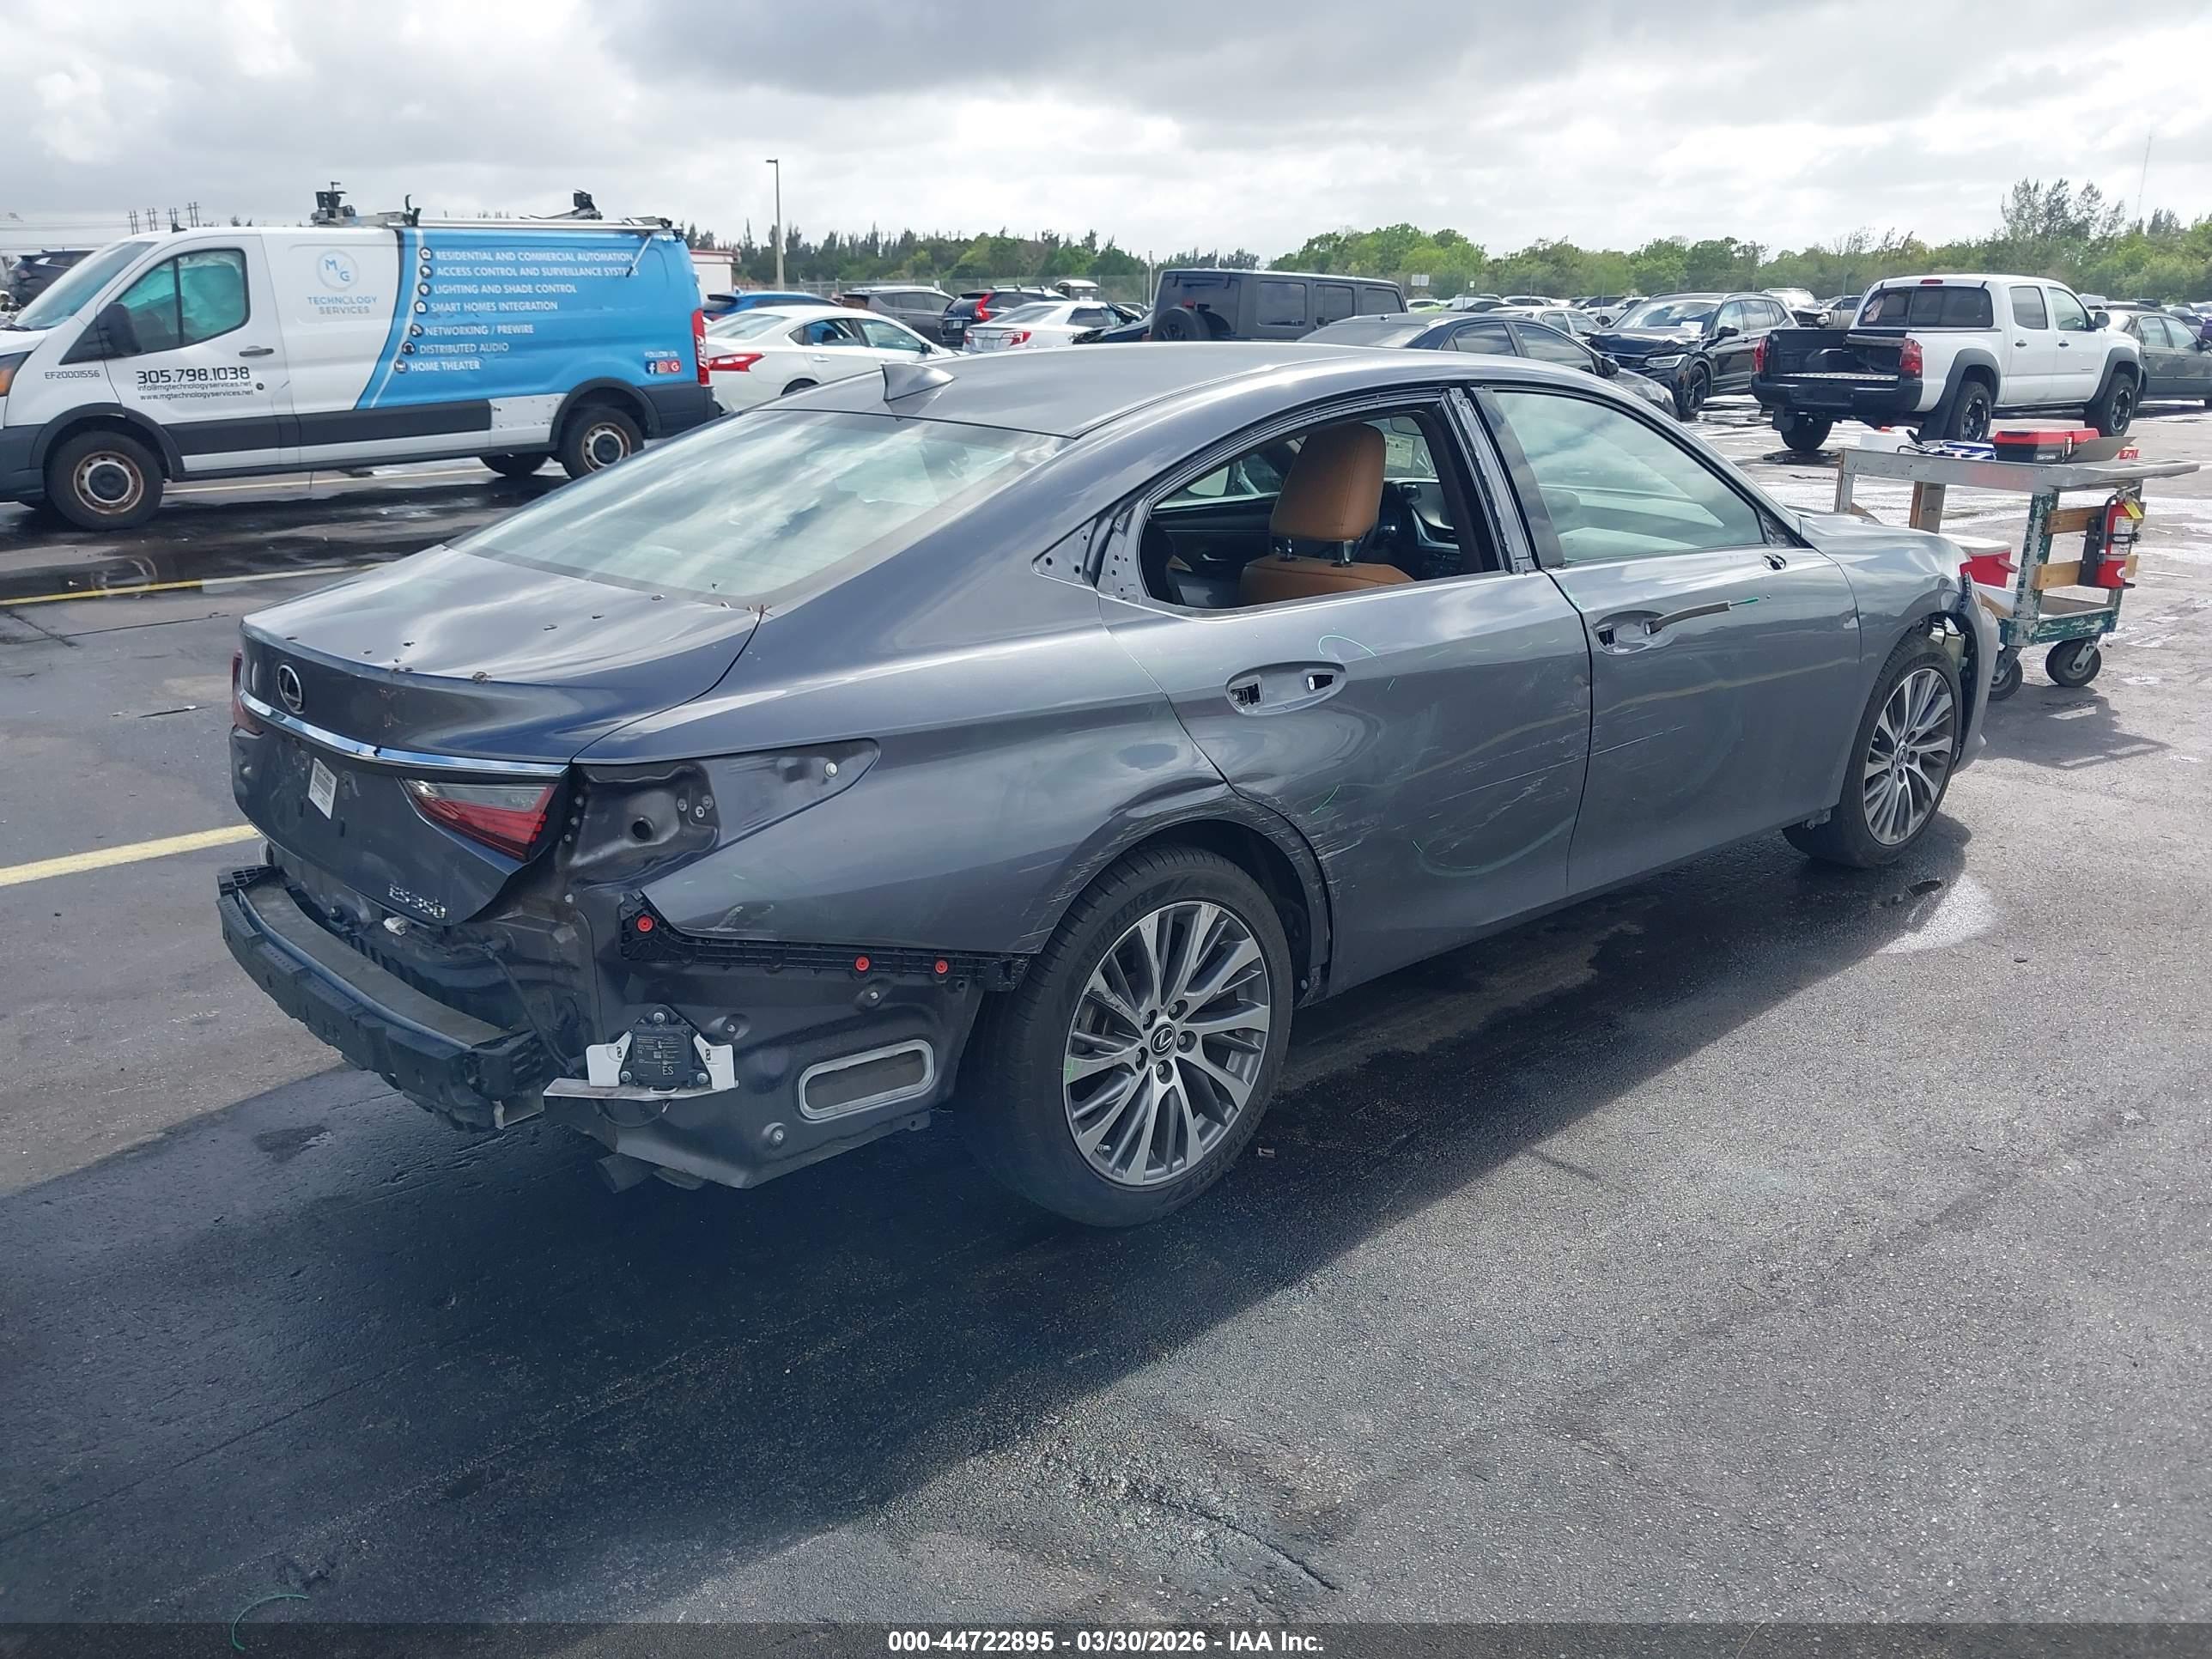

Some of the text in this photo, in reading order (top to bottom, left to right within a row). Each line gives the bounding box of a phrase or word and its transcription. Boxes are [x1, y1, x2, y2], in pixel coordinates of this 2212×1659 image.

[435, 251, 634, 262] RESIDENTIAL AND COMMERCIAL AUTOMATION
[436, 267, 472, 276] ACCESS
[473, 267, 518, 276] CONTROL
[520, 267, 540, 276] AND
[542, 267, 603, 276] SURVEILLANCE
[434, 284, 577, 294] LIGHTING AND SHADE CONTROL
[307, 296, 378, 306] TECHNOLOGY
[430, 301, 558, 312] SMART HOMES INTEGRATION
[319, 306, 370, 315] SERVICES
[425, 325, 489, 336] NETWORKING
[496, 325, 534, 335] PREWIRE
[419, 343, 509, 354] DISTRIBUTED AUDIO
[411, 361, 481, 372] HOME THEATER
[136, 367, 250, 384] 305.798.1038
[137, 381, 252, 392] info@mgtechnologyservices.net
[140, 390, 254, 400] www.mgtechnologyservices.net
[389, 883, 410, 903] ES
[662, 1066, 674, 1076] ES
